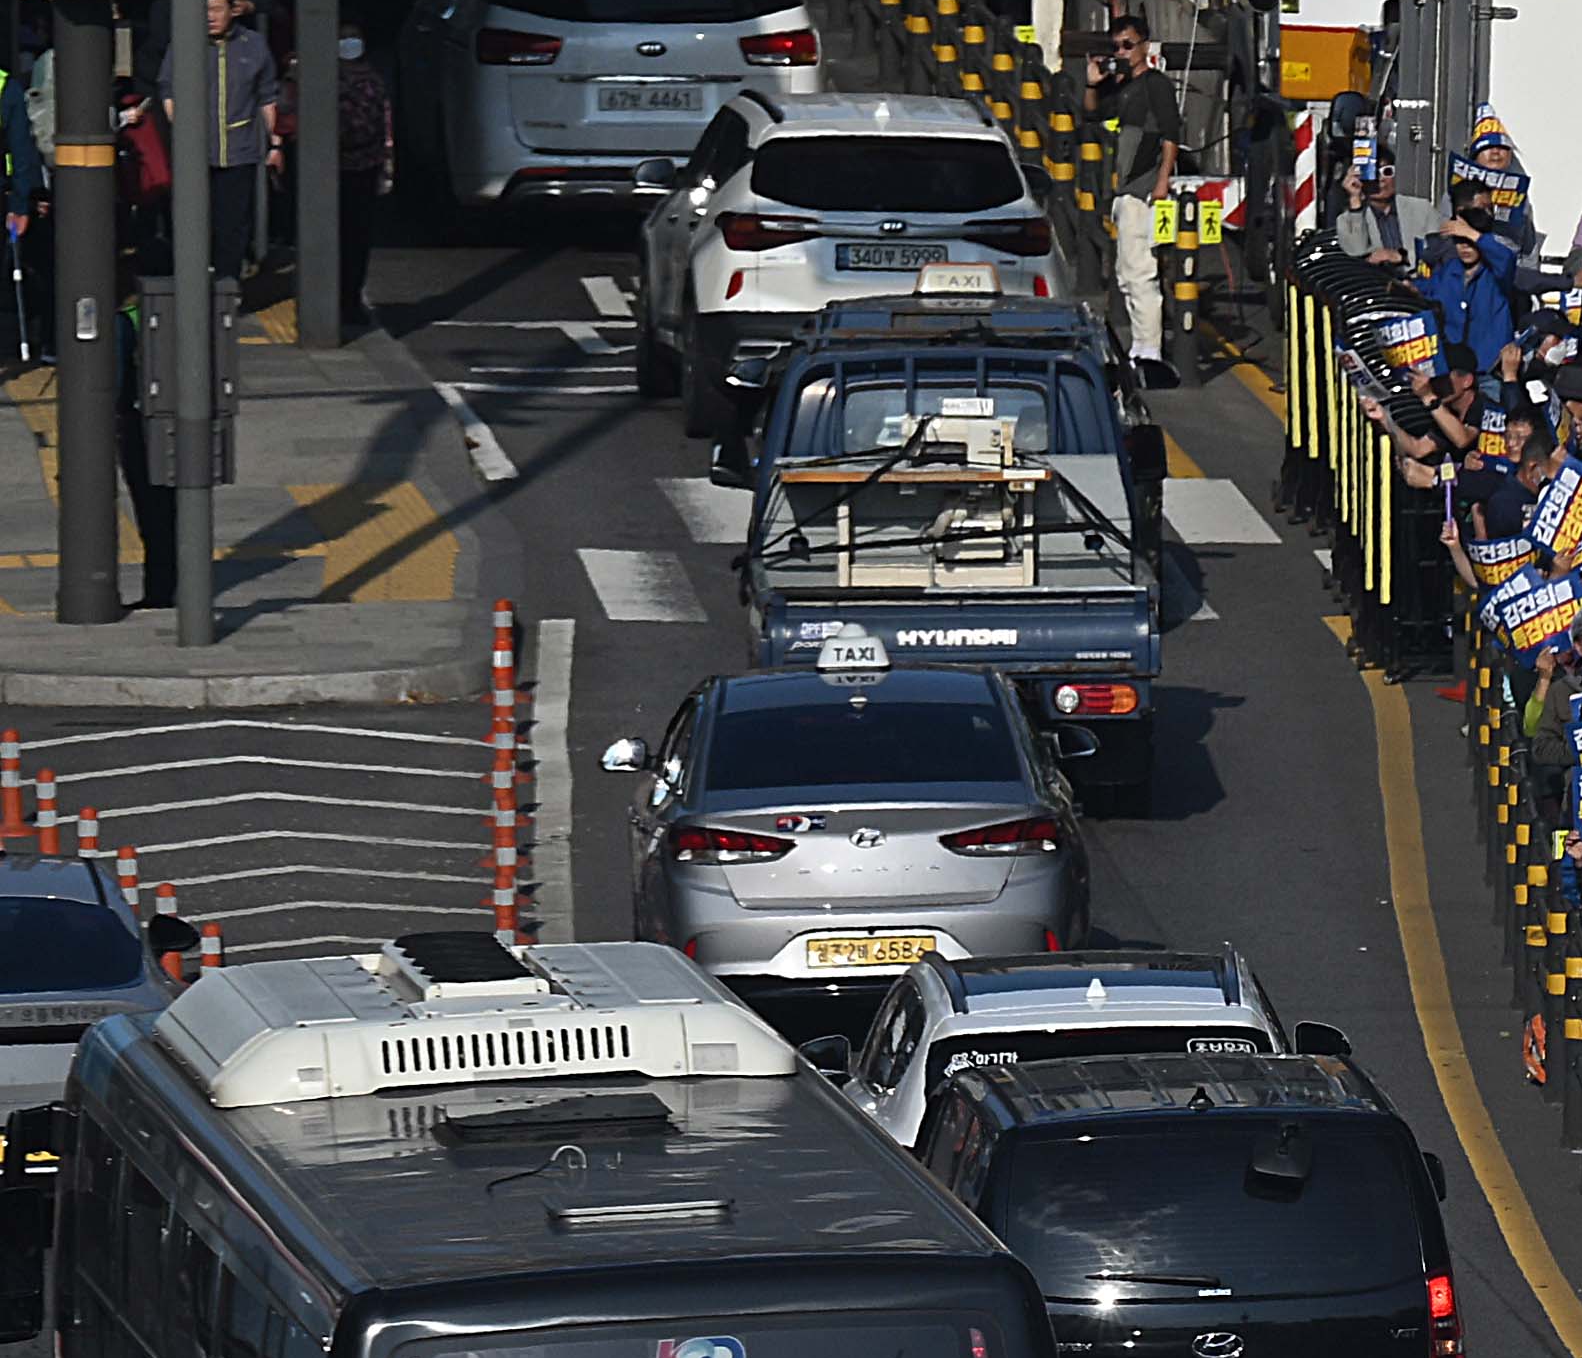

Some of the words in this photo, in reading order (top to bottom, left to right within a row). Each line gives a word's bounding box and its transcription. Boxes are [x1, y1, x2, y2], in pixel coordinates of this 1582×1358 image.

[933, 274, 982, 290] TAXI
[896, 626, 1018, 646] HYUNDAI
[833, 646, 876, 662] TAXI
